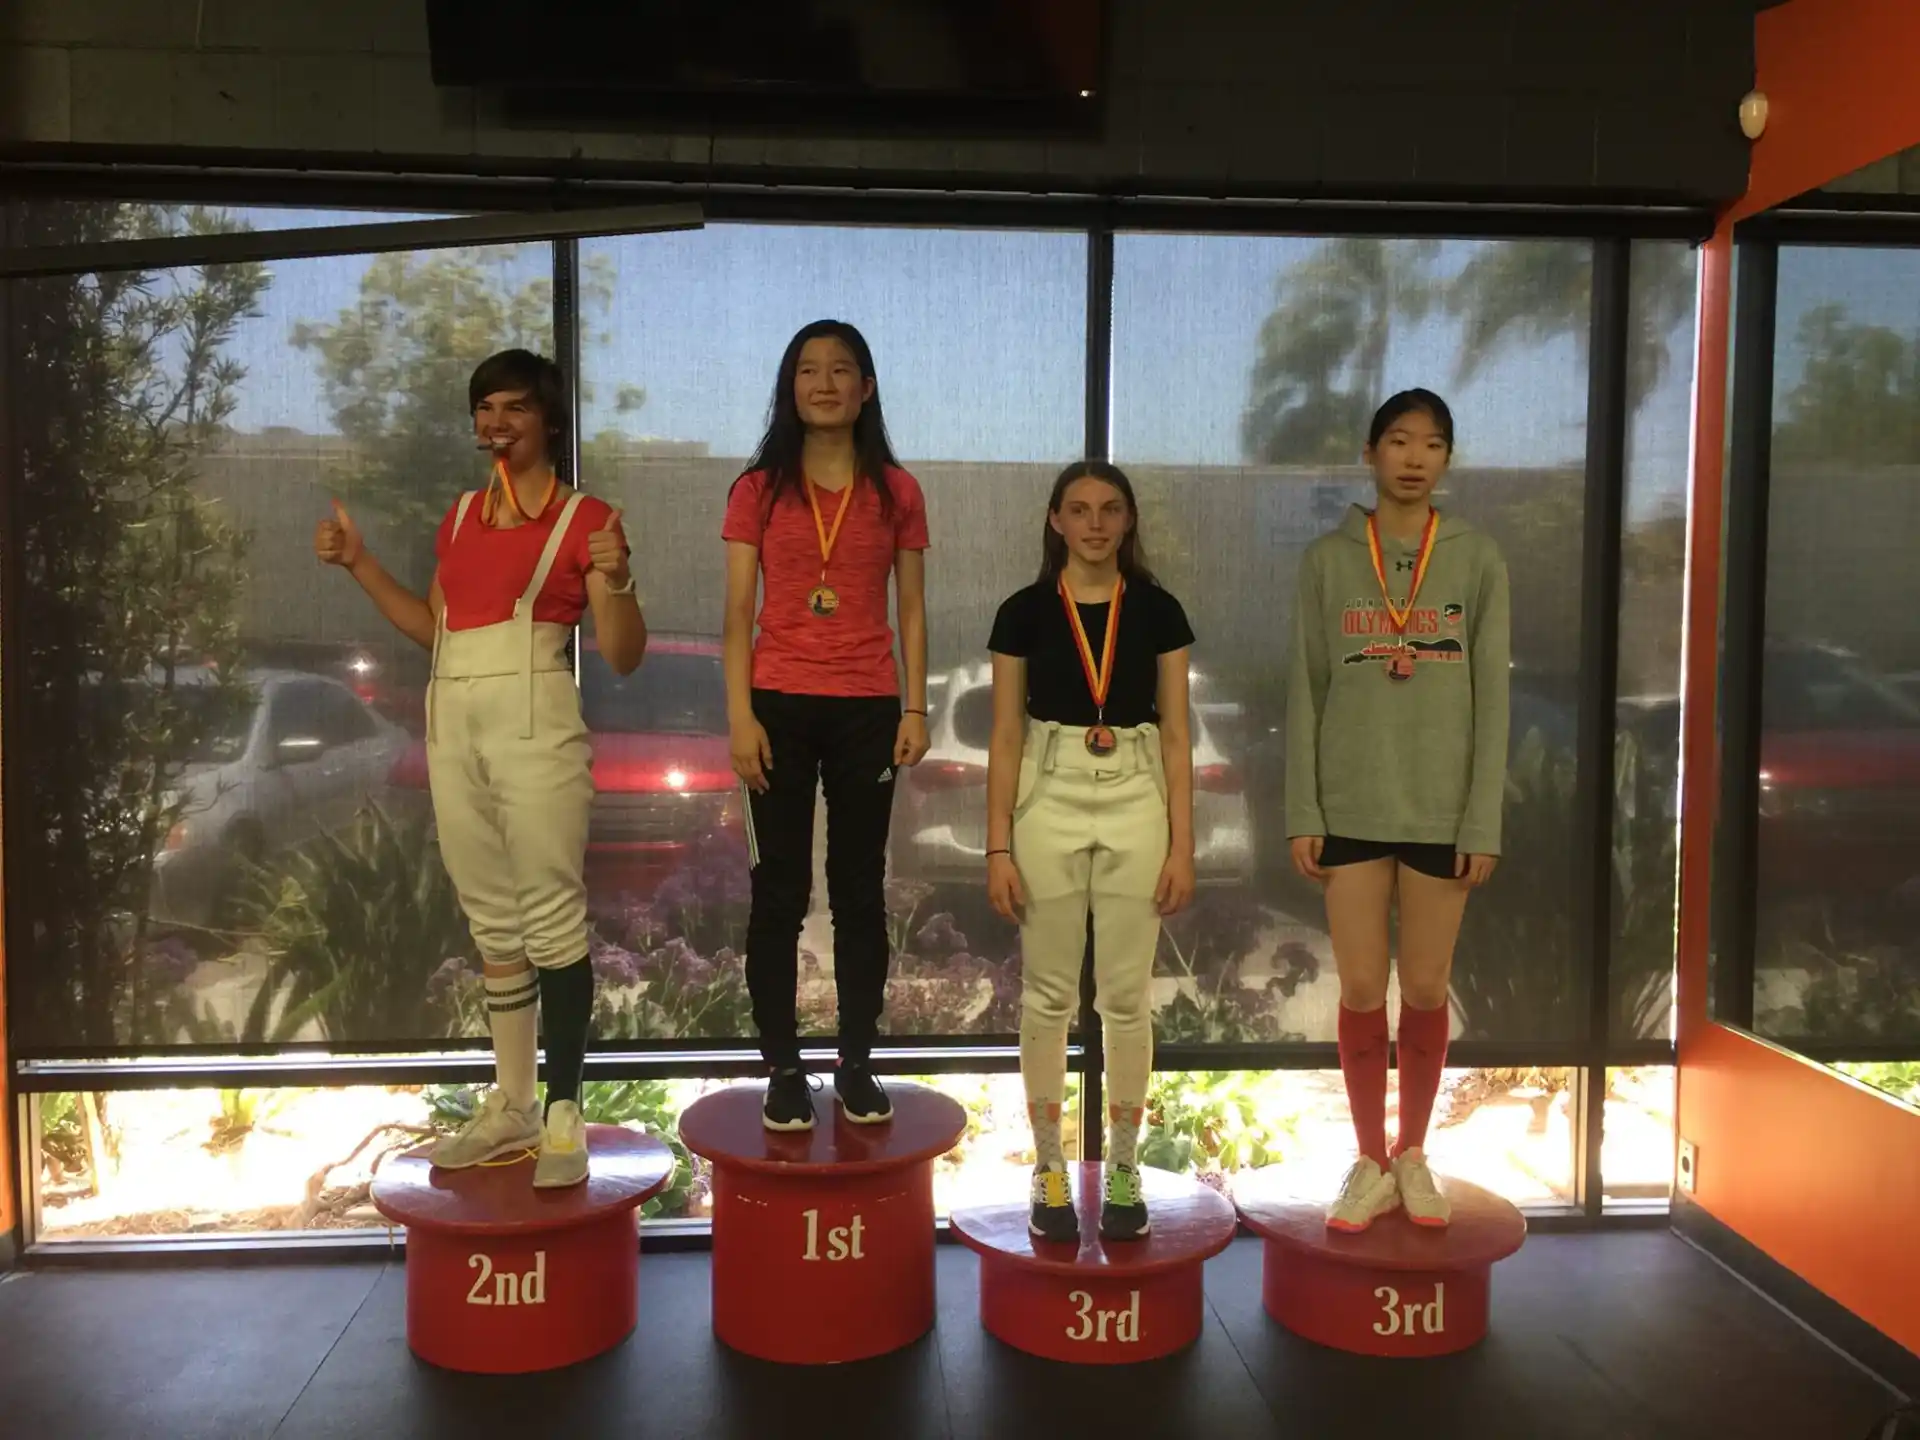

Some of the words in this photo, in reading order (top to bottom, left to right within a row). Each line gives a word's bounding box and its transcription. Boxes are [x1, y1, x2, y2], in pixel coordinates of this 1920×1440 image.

[1343, 609, 1438, 634] OLYMICS
[802, 1209, 866, 1261] 1st
[466, 1251, 546, 1306] 2nd
[1065, 1290, 1140, 1342] 3rd
[1373, 1282, 1444, 1336] 3rd
